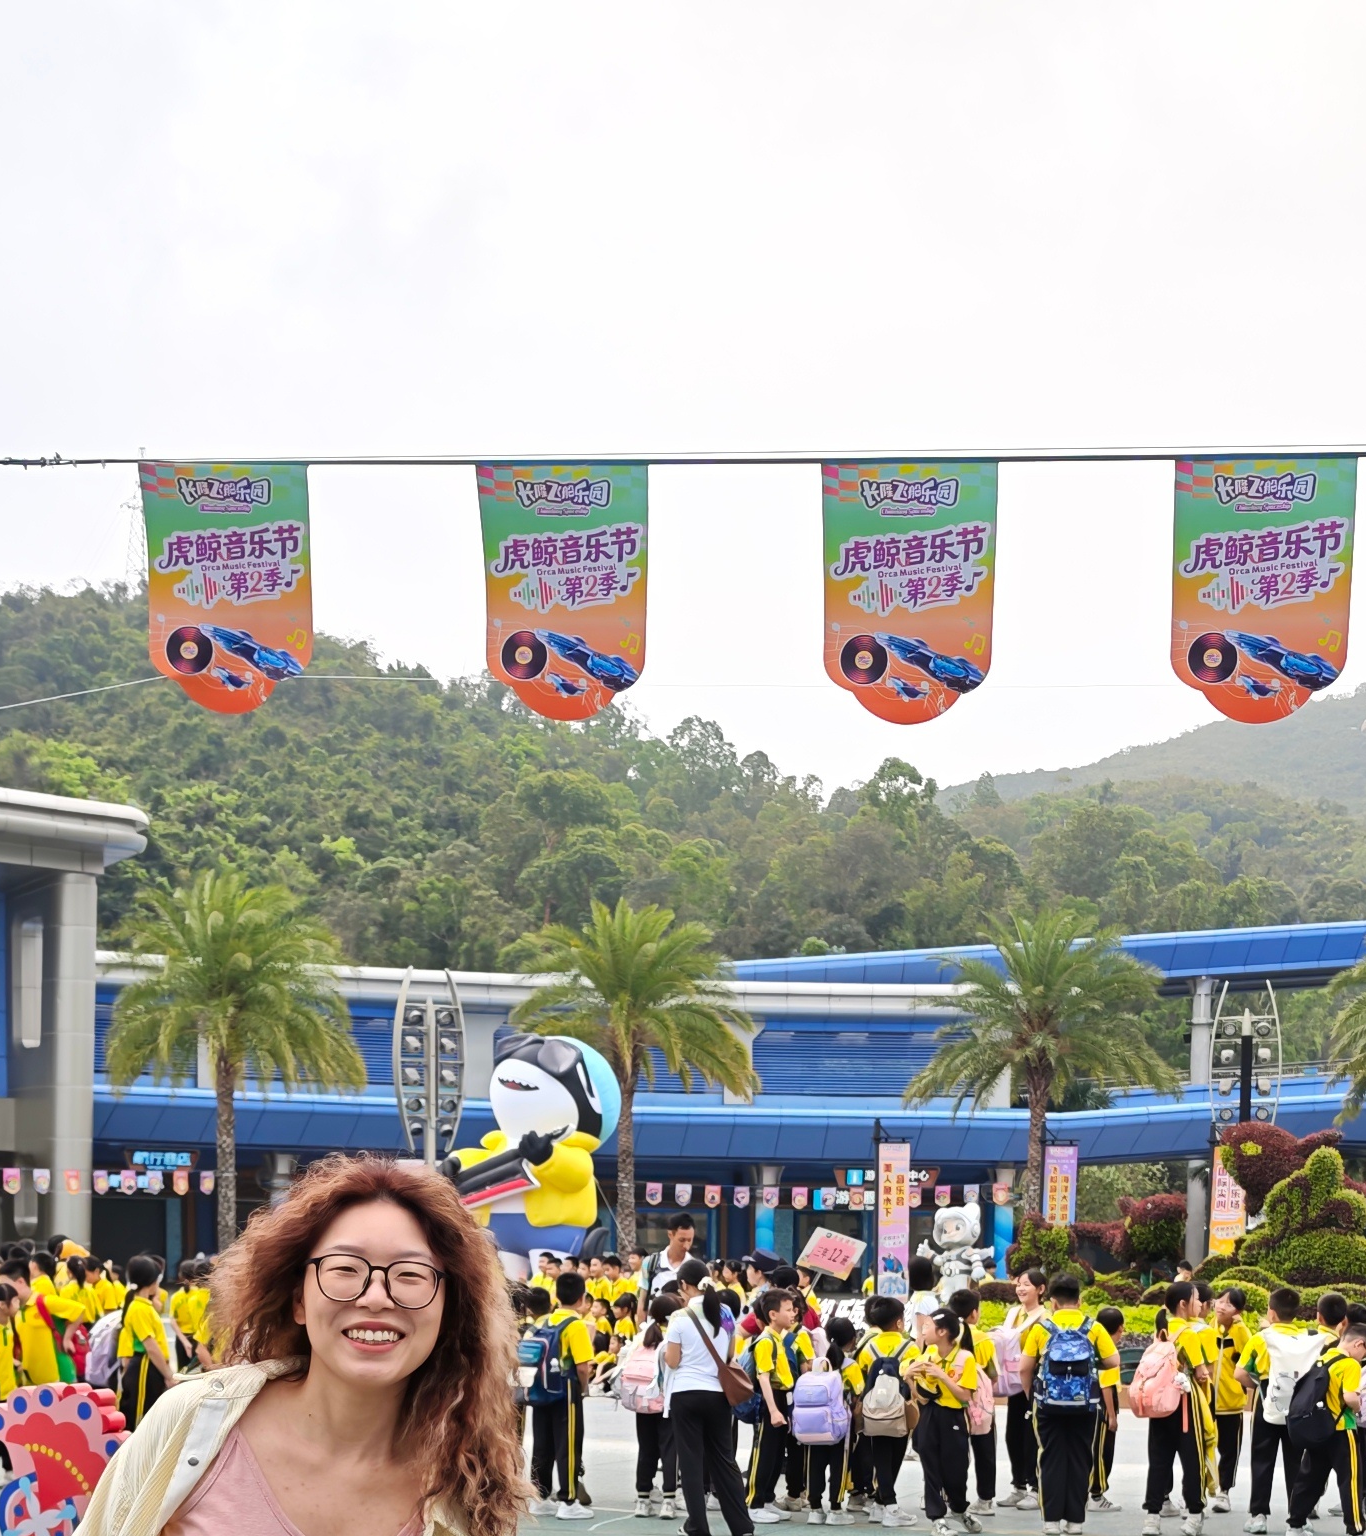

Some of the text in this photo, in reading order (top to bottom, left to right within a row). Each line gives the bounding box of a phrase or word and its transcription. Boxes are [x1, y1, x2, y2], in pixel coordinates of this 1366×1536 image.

[181, 479, 269, 503] 长隆飞船乐园
[517, 481, 609, 506] 长隆飞船乐园
[863, 479, 957, 506] 长隆飞船乐园
[1217, 474, 1315, 502] 长隆飞船乐园
[159, 524, 300, 569] 虎鲸音乐节
[495, 527, 638, 573] 虎鲸音乐节
[835, 526, 986, 576] 虎鲸音乐节
[1185, 521, 1344, 573] 虎鲸音乐节
[248, 560, 280, 568] Festival
[583, 564, 616, 572] Festival
[927, 563, 962, 573] Festival
[1252, 565, 1278, 574] Music
[1280, 560, 1317, 569] Festival
[223, 568, 285, 600] 第2季
[558, 571, 621, 606] 第2季
[900, 571, 966, 608] 第2季
[1252, 568, 1321, 605] 第2季
